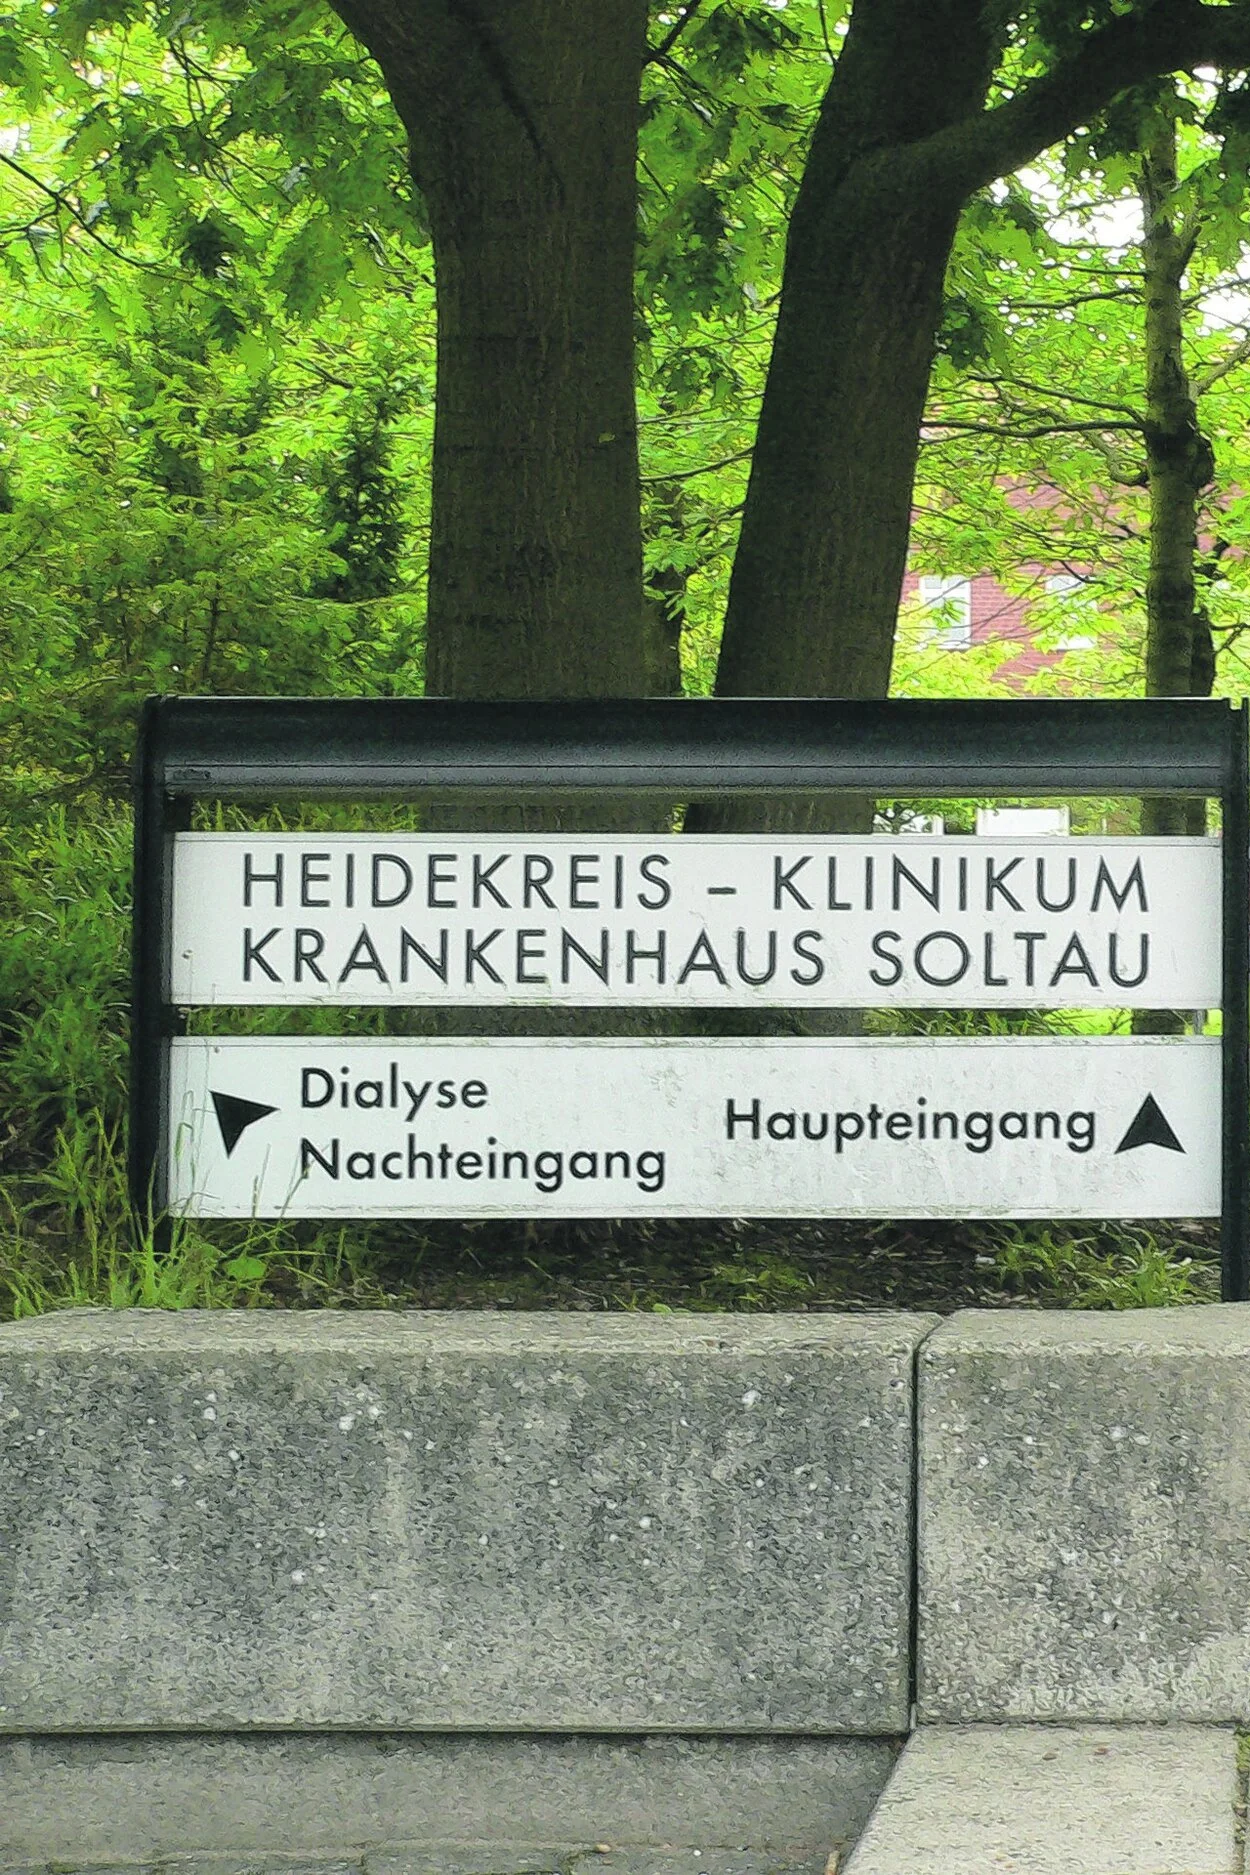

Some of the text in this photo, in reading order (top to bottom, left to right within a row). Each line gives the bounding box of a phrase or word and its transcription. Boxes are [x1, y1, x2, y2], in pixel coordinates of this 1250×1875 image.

[244, 853, 672, 910] HEIDEKREIS
[774, 854, 1148, 913] KLINIKUM
[243, 926, 1150, 988] KRANKENHAUS SOLTAU
[301, 1062, 488, 1123] Dialyse
[726, 1097, 1096, 1154] Haupteingang
[300, 1133, 666, 1193] Nachteingang
